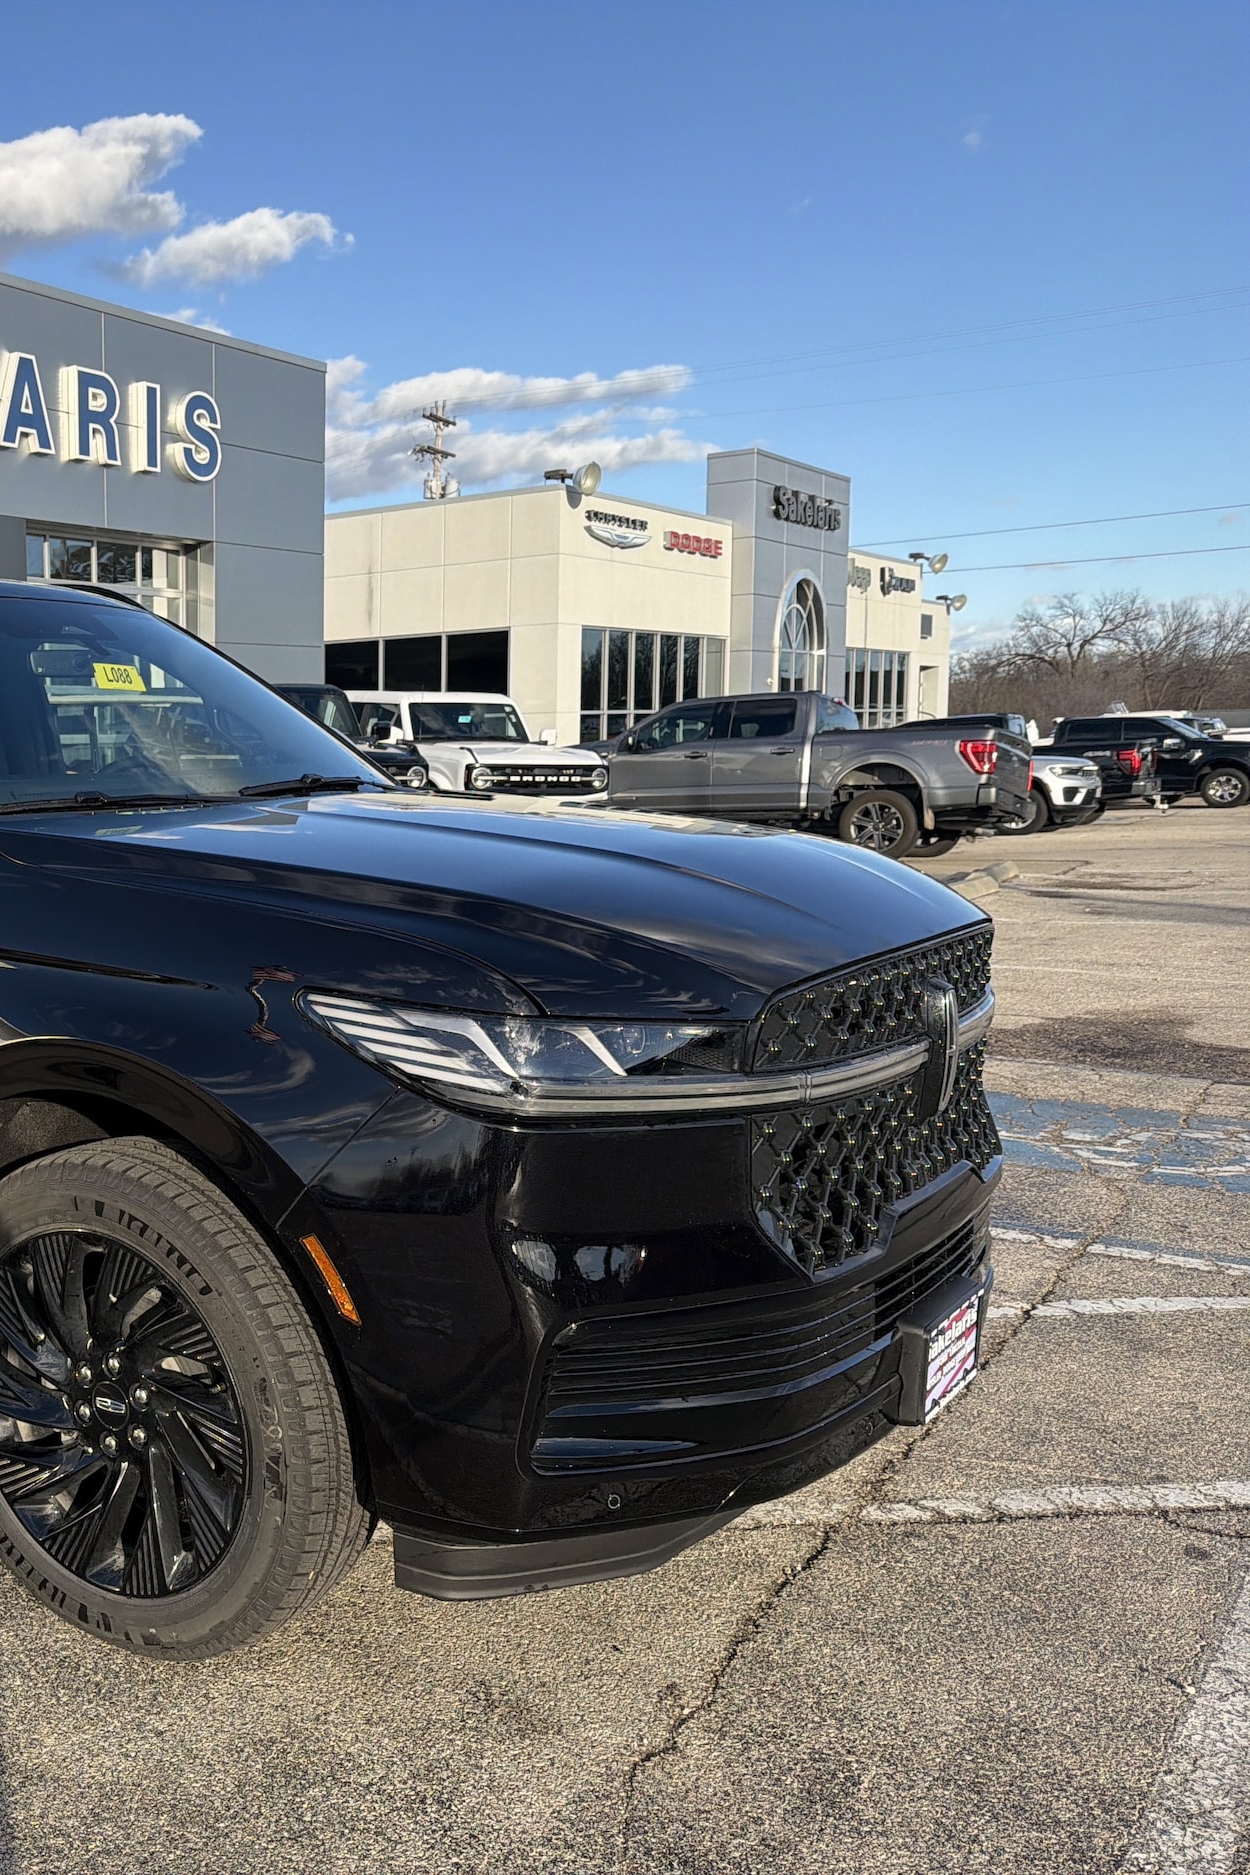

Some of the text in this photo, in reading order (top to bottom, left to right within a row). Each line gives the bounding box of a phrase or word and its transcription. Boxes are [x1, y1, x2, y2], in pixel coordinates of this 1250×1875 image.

[774, 485, 841, 531] Sakelaris
[664, 531, 723, 558] DODGE
[103, 666, 133, 685] L088
